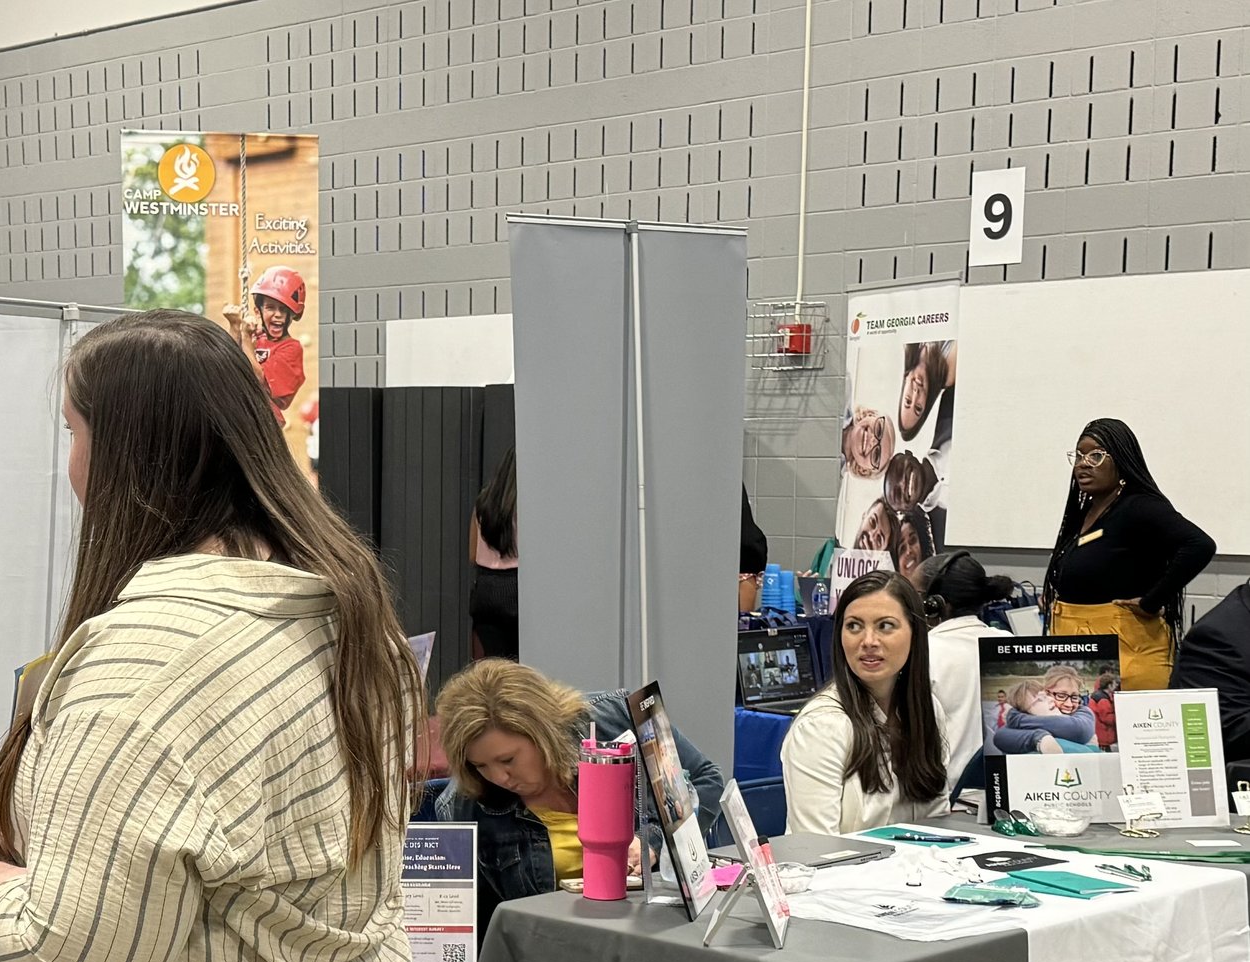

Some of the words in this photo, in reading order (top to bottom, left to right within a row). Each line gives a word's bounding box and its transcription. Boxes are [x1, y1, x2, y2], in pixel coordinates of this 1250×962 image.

[123, 188, 162, 201] CAMP
[123, 200, 240, 217] WESTMINSTER
[982, 192, 1014, 240] 9
[255, 213, 308, 240] Exciting
[866, 320, 885, 330] TEAM
[886, 316, 916, 328] GEORGIA
[917, 312, 949, 325] CAREERS
[997, 645, 1011, 654] BE
[1013, 644, 1033, 654] THE
[1035, 643, 1099, 653] DIFFERENCE
[1024, 792, 1060, 802] AIKEN
[1063, 790, 1113, 801] COUNTY
